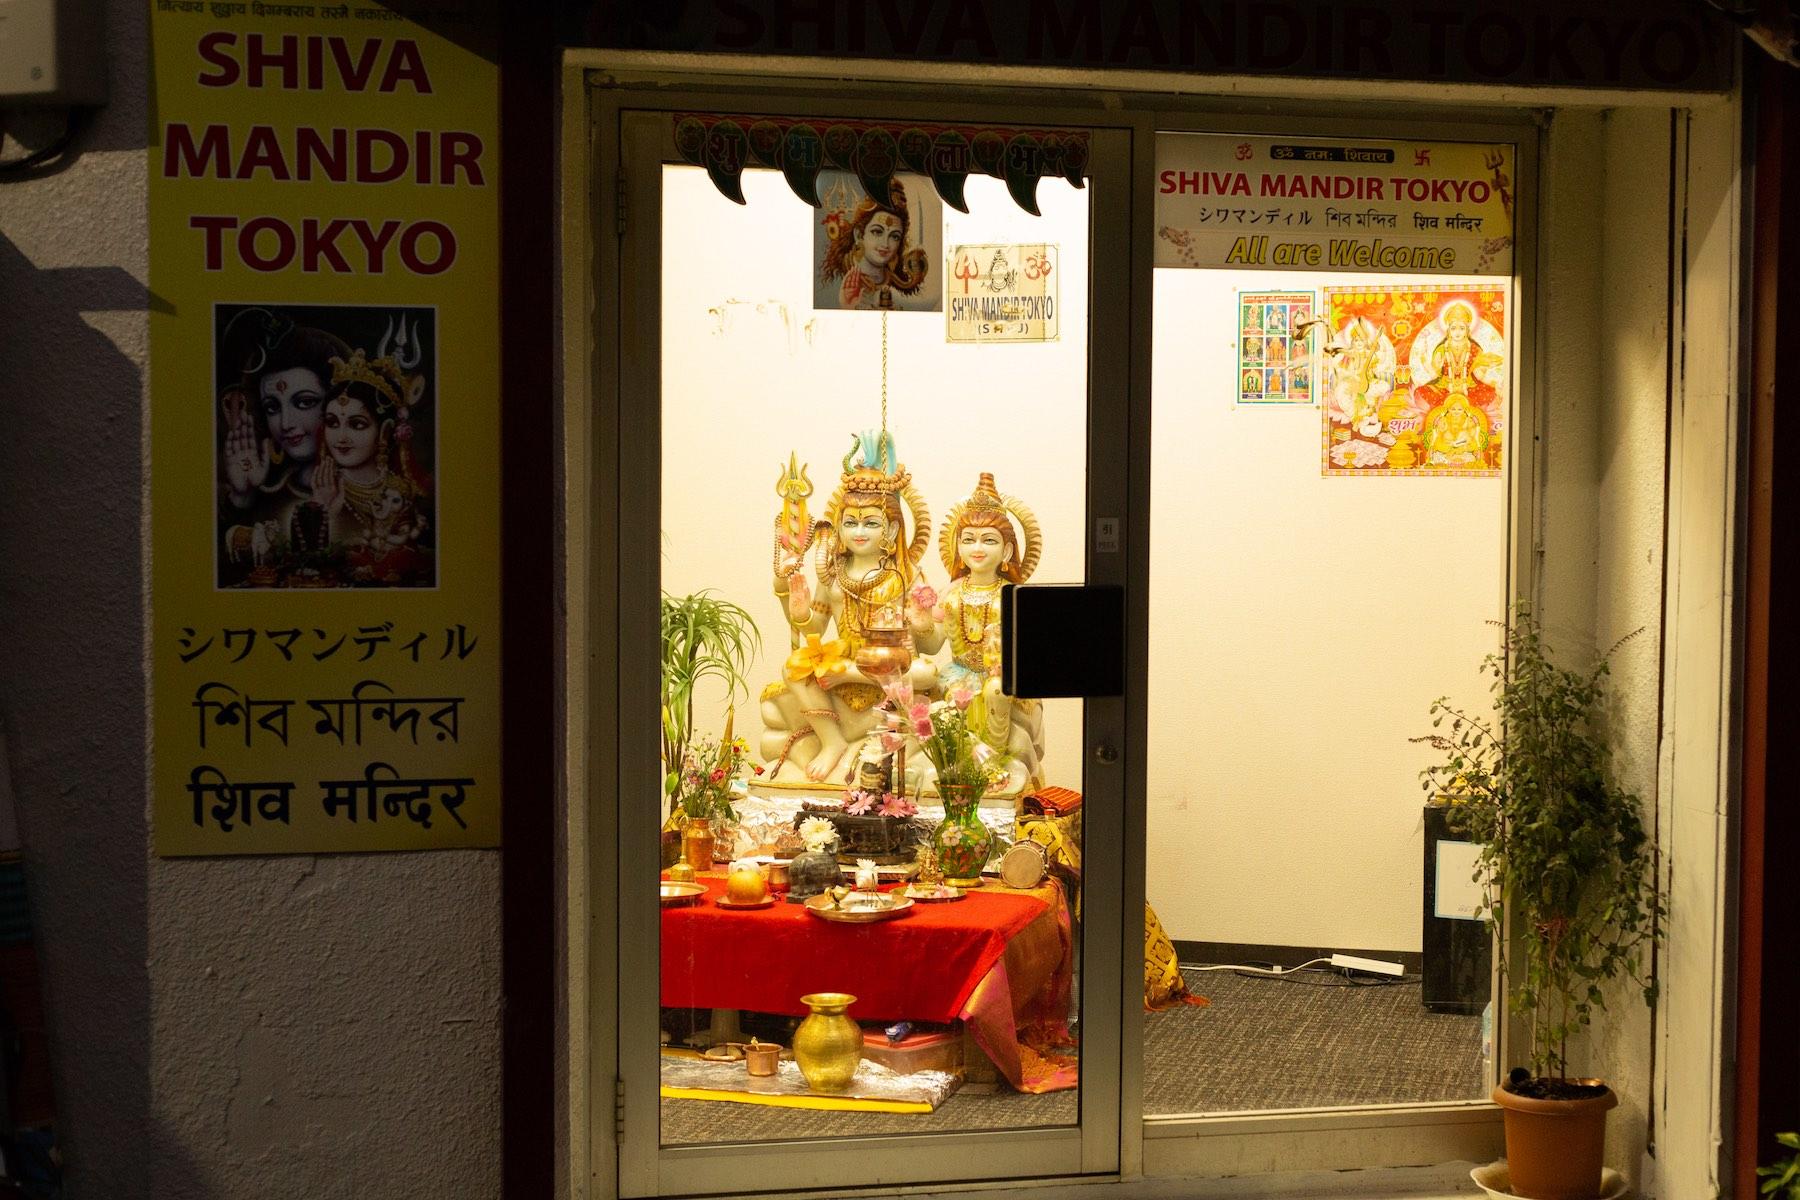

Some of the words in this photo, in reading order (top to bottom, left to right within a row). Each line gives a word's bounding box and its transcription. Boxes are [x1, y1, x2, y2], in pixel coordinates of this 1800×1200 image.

[198, 32, 432, 94] SHIVA
[713, 0, 999, 58] SHIVA
[1025, 0, 1393, 75] MANDIR
[1411, 10, 1700, 83] TOKYO
[165, 124, 484, 186] MANDIR
[1160, 170, 1252, 196] SHIVA
[1261, 174, 1384, 200] MANDIR
[1390, 178, 1490, 204] TOKYO
[1199, 207, 1312, 226] シワマンディル
[1414, 212, 1439, 230] शिव
[191, 217, 456, 275] TOKYO
[1226, 236, 1266, 264] All
[1273, 243, 1321, 265] are
[1329, 240, 1456, 269] Welcome
[1022, 296, 1053, 320] TOKYO
[178, 621, 479, 663] シワマンディル
[192, 681, 295, 748] শিব
[307, 679, 465, 746] মন্দির
[186, 765, 296, 832] शिव
[319, 762, 475, 829] मन्दिर
